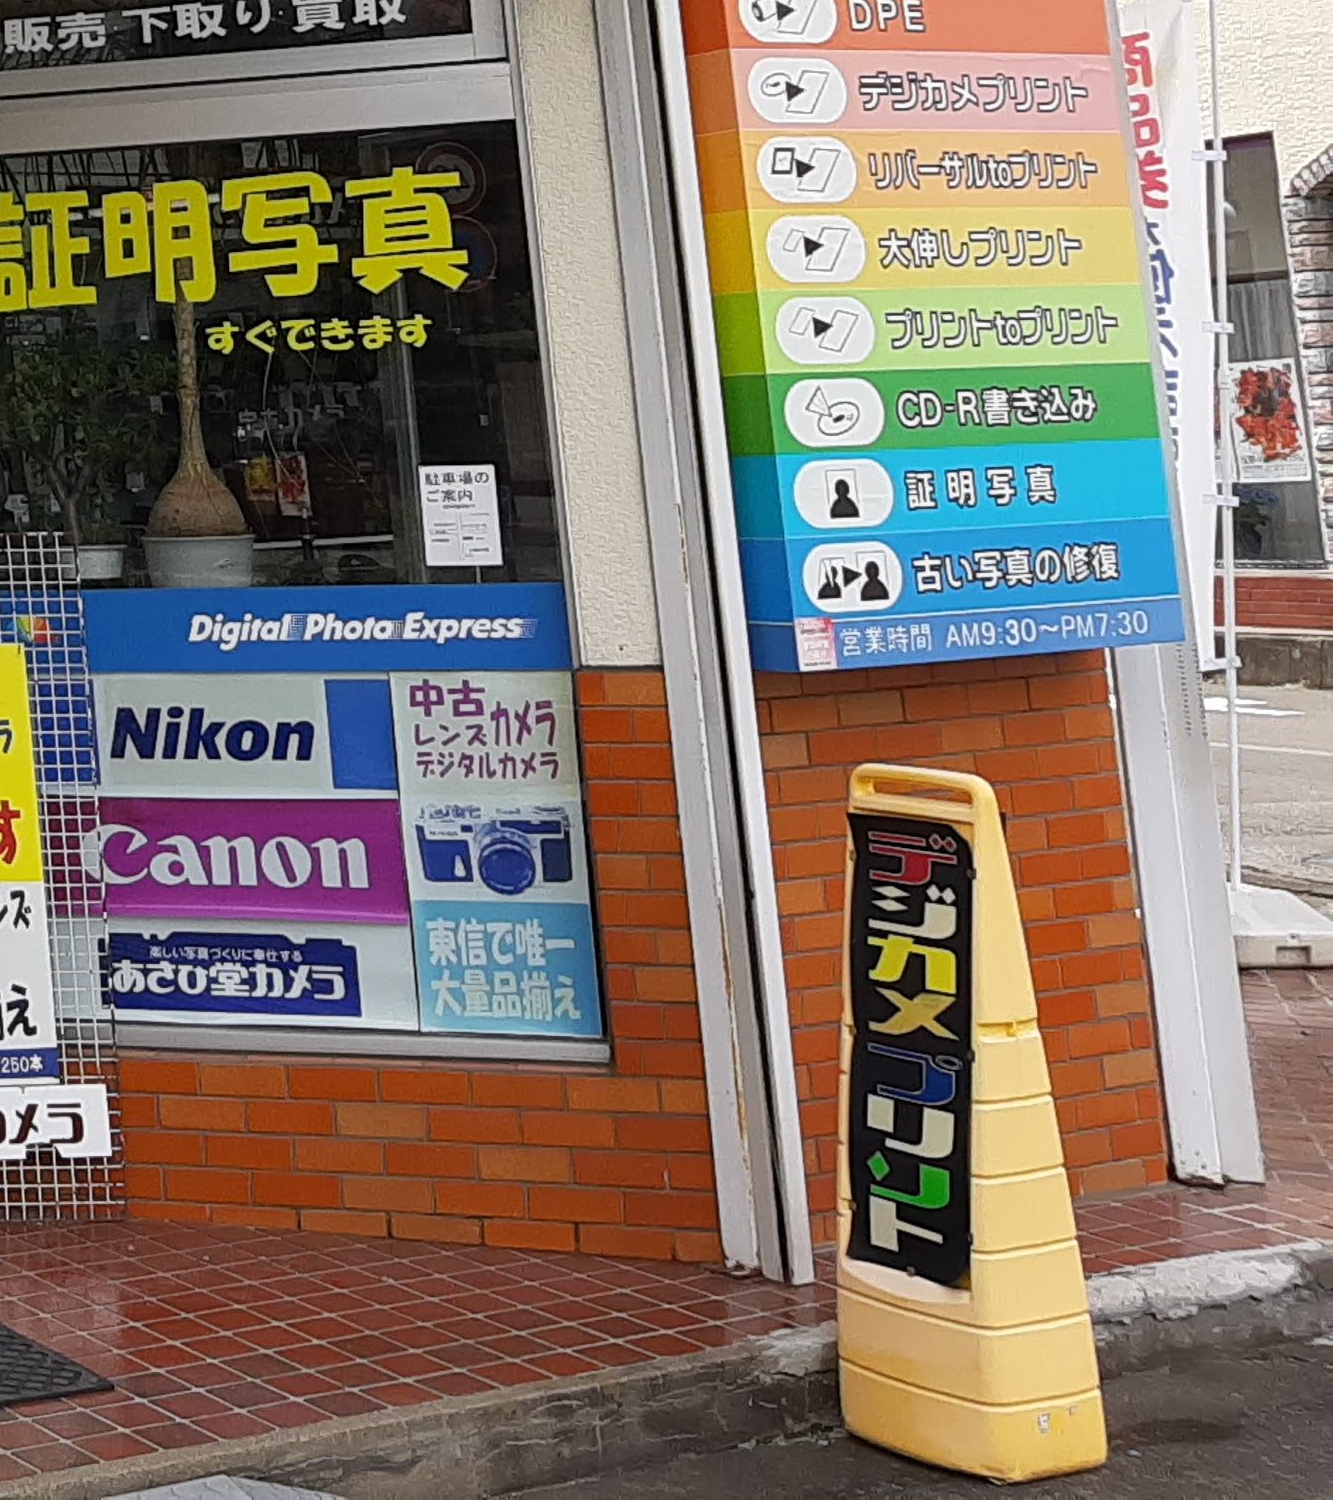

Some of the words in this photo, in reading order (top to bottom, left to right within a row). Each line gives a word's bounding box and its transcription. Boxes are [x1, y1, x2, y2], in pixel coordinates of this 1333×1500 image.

[858, 70, 1088, 113] デジカメプリント
[868, 148, 1098, 191] リバーサルtoプリント
[879, 227, 1083, 268] 大伸しプリント
[204, 313, 433, 356] すぐできます
[884, 306, 1119, 350] プリントtoプリント
[896, 385, 1098, 428] CD-R書き込み
[904, 463, 1057, 510] 証明写真
[912, 542, 1121, 595] 古い写真の修復
[188, 612, 291, 651] Digital
[303, 611, 394, 642] Photo
[403, 611, 524, 645] Express
[840, 623, 933, 658] 営業時間
[109, 706, 315, 762] Nikon
[409, 678, 487, 719] 中古
[492, 699, 556, 749] カメラ
[413, 722, 487, 748] レンズ
[416, 752, 559, 780] デジタルカメラ
[81, 822, 370, 890] Canon
[149, 943, 303, 963] 楽しい写真づくりに奉仕する
[425, 918, 577, 967] 東信で唯一
[109, 958, 347, 1000] あさひ堂カメラ
[431, 970, 582, 1021] 大量品揃え
[867, 829, 964, 1255] デジカメプリント
